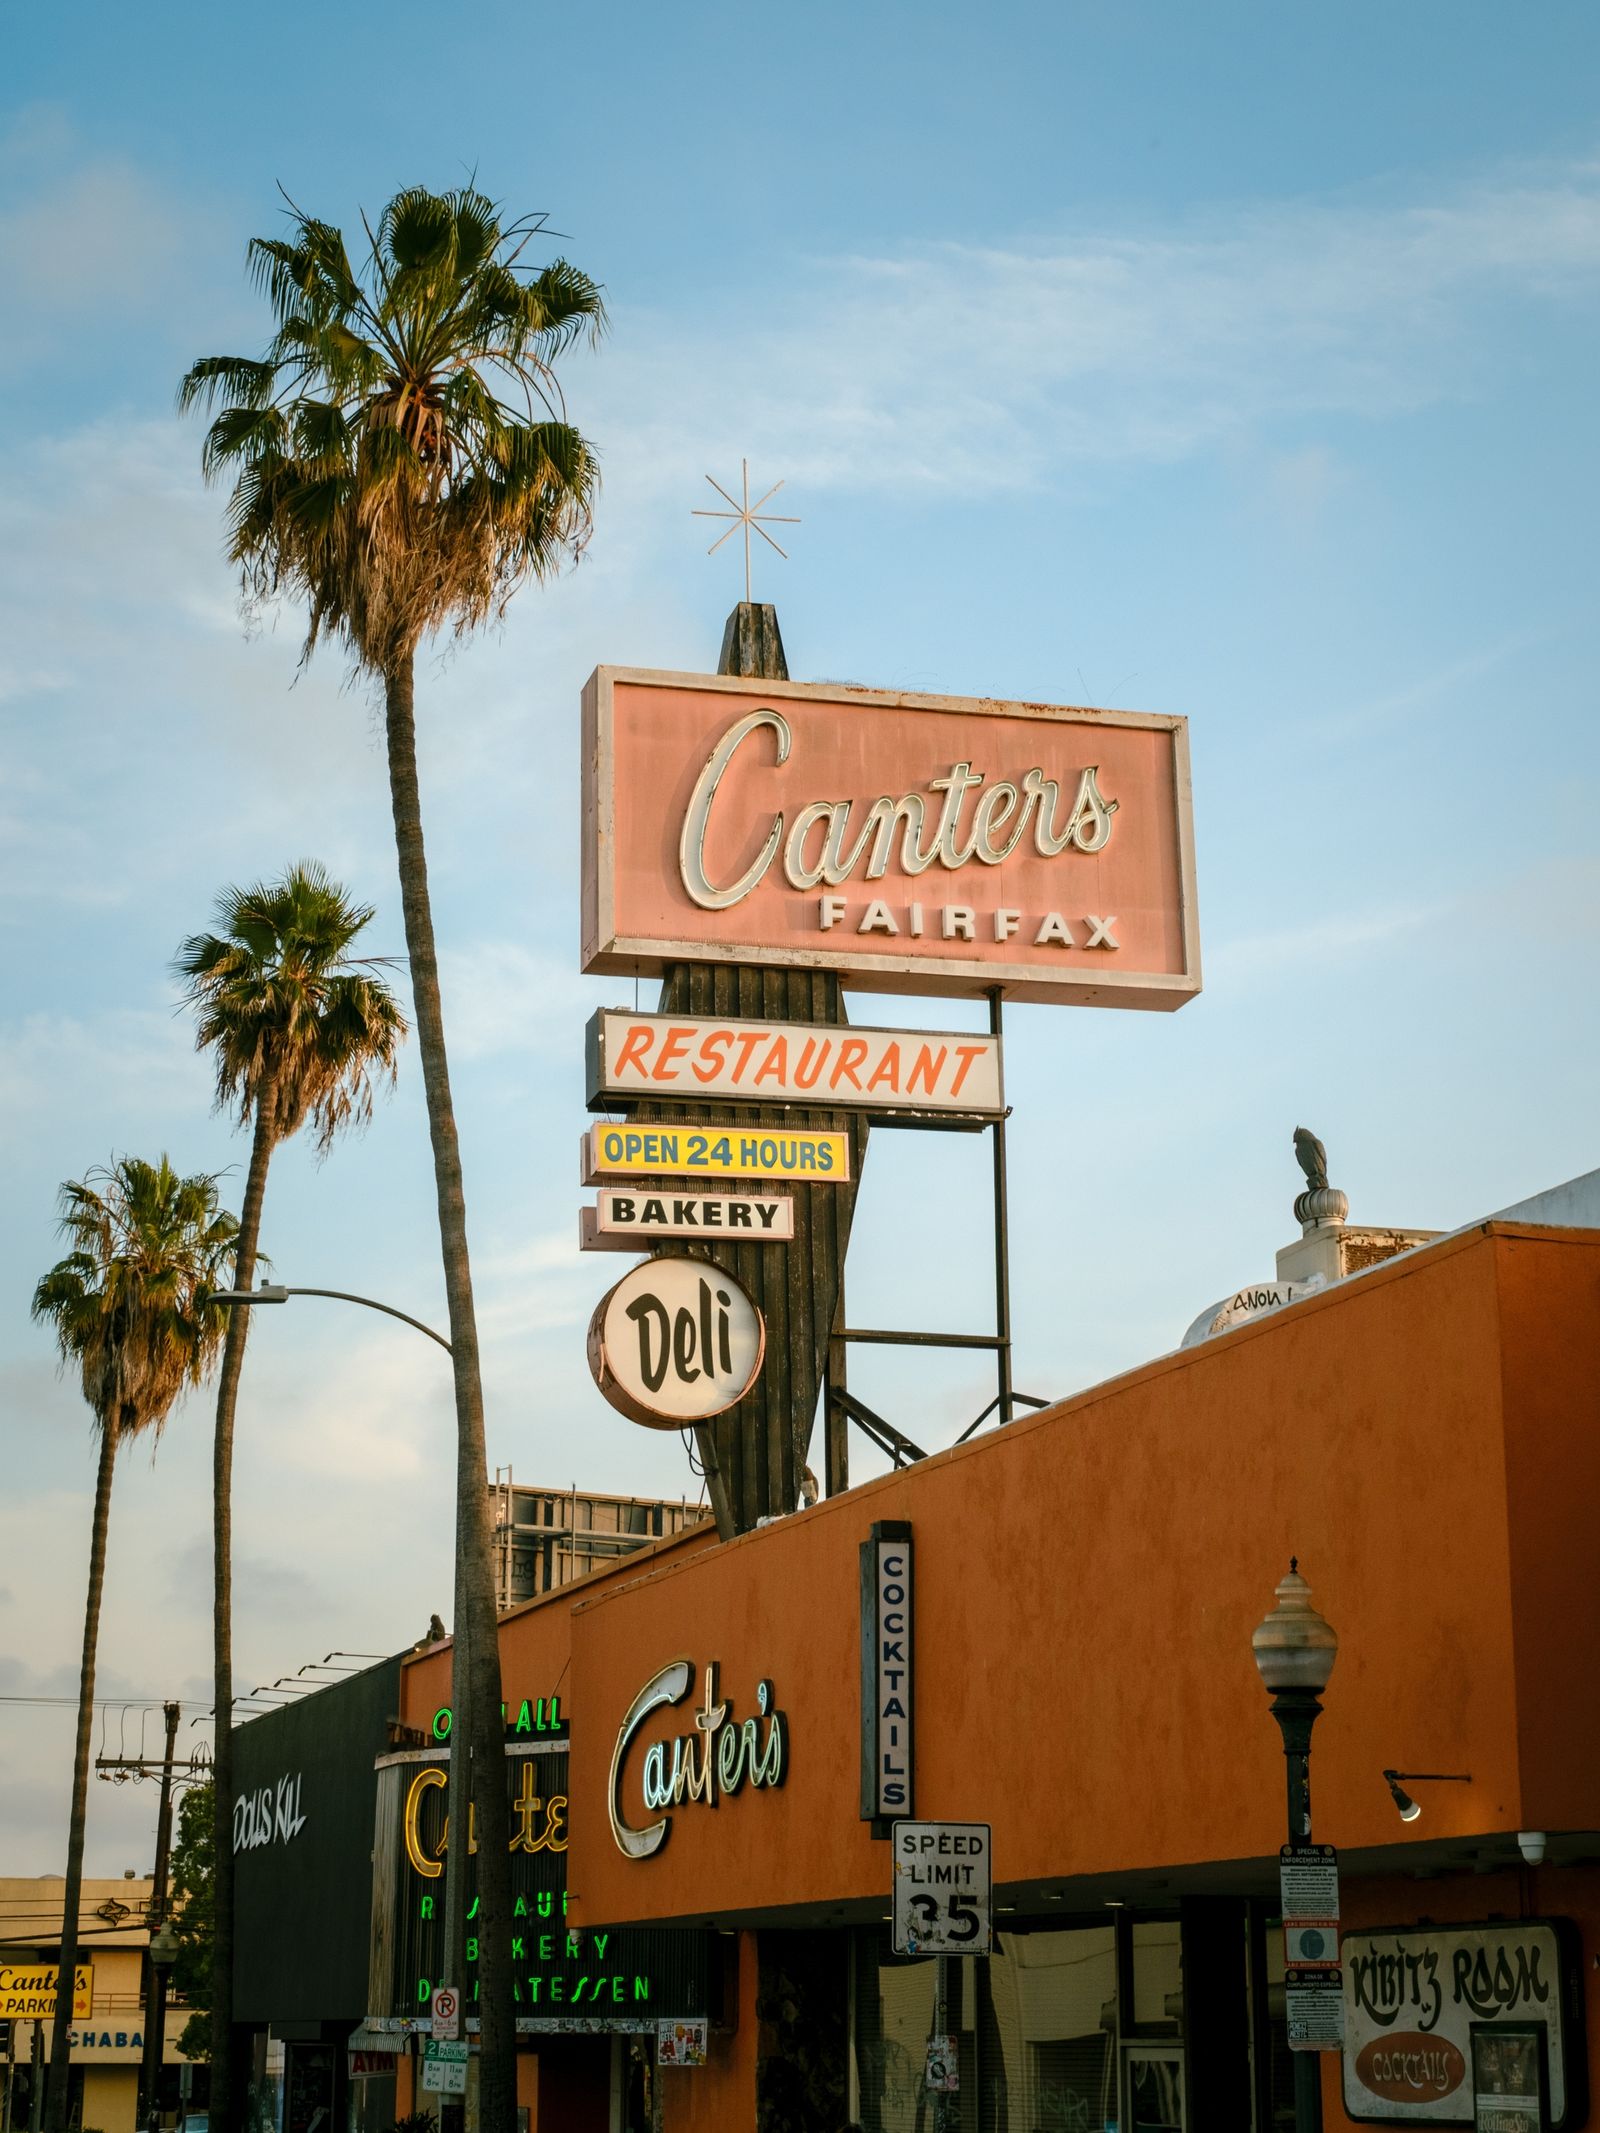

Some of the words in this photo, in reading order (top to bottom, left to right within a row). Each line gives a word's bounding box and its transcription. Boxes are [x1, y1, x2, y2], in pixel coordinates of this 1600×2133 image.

[680, 708, 1120, 911] Canters
[819, 896, 1120, 951] FAIRFAX
[614, 1025, 988, 1097] RESTAURANT
[604, 1133, 678, 1164] OPEN
[686, 1135, 733, 1166] 24
[740, 1138, 834, 1171] HOURS
[611, 1197, 779, 1229] BAKERY
[625, 1277, 732, 1393] Deli
[882, 1555, 906, 1805] COCKTAILS
[516, 1697, 562, 1733] ALL
[608, 1660, 788, 1858] Canter's
[273, 1771, 308, 1846] KILL
[903, 1835, 983, 1854] SPEED
[911, 1865, 974, 1884] LIMIT
[910, 1894, 980, 1942] 35
[465, 1934, 609, 1962] BKERY
[0, 1968, 87, 1991] Cant's
[417, 1976, 650, 2003] DITESSEN
[1453, 1946, 1549, 2019] ROOM
[6, 1998, 57, 2013] PARKI
[353, 2051, 394, 2073] ATM
[428, 2042, 437, 2055] 2
[440, 2048, 466, 2059] PARKING
[1372, 2050, 1450, 2091] COCKTAILS
